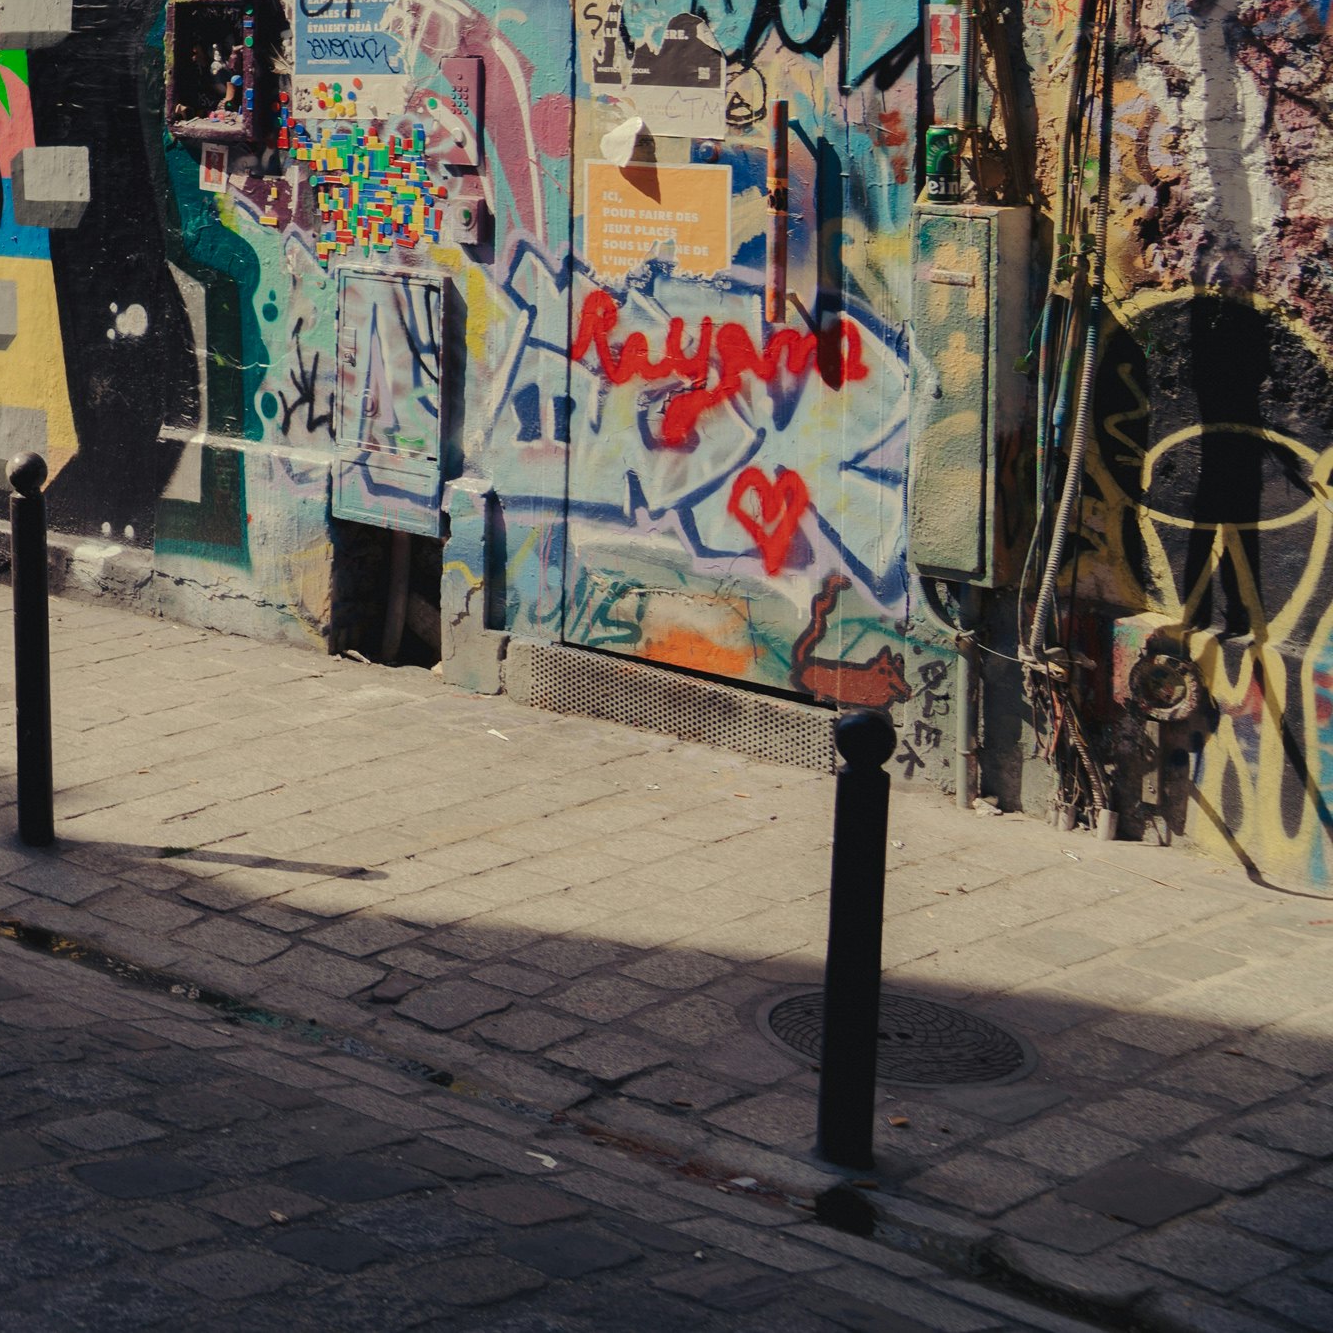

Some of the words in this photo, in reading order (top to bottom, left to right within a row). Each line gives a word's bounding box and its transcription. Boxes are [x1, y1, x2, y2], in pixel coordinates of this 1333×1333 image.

[602, 191, 623, 203] ICI,
[602, 207, 636, 219] POUR
[638, 209, 673, 221] FAIRE
[676, 212, 699, 223] DES
[602, 223, 631, 235] JEUX
[634, 225, 677, 237] PLACÉS
[602, 239, 634, 251] SOUS
[693, 246, 709, 257] DE
